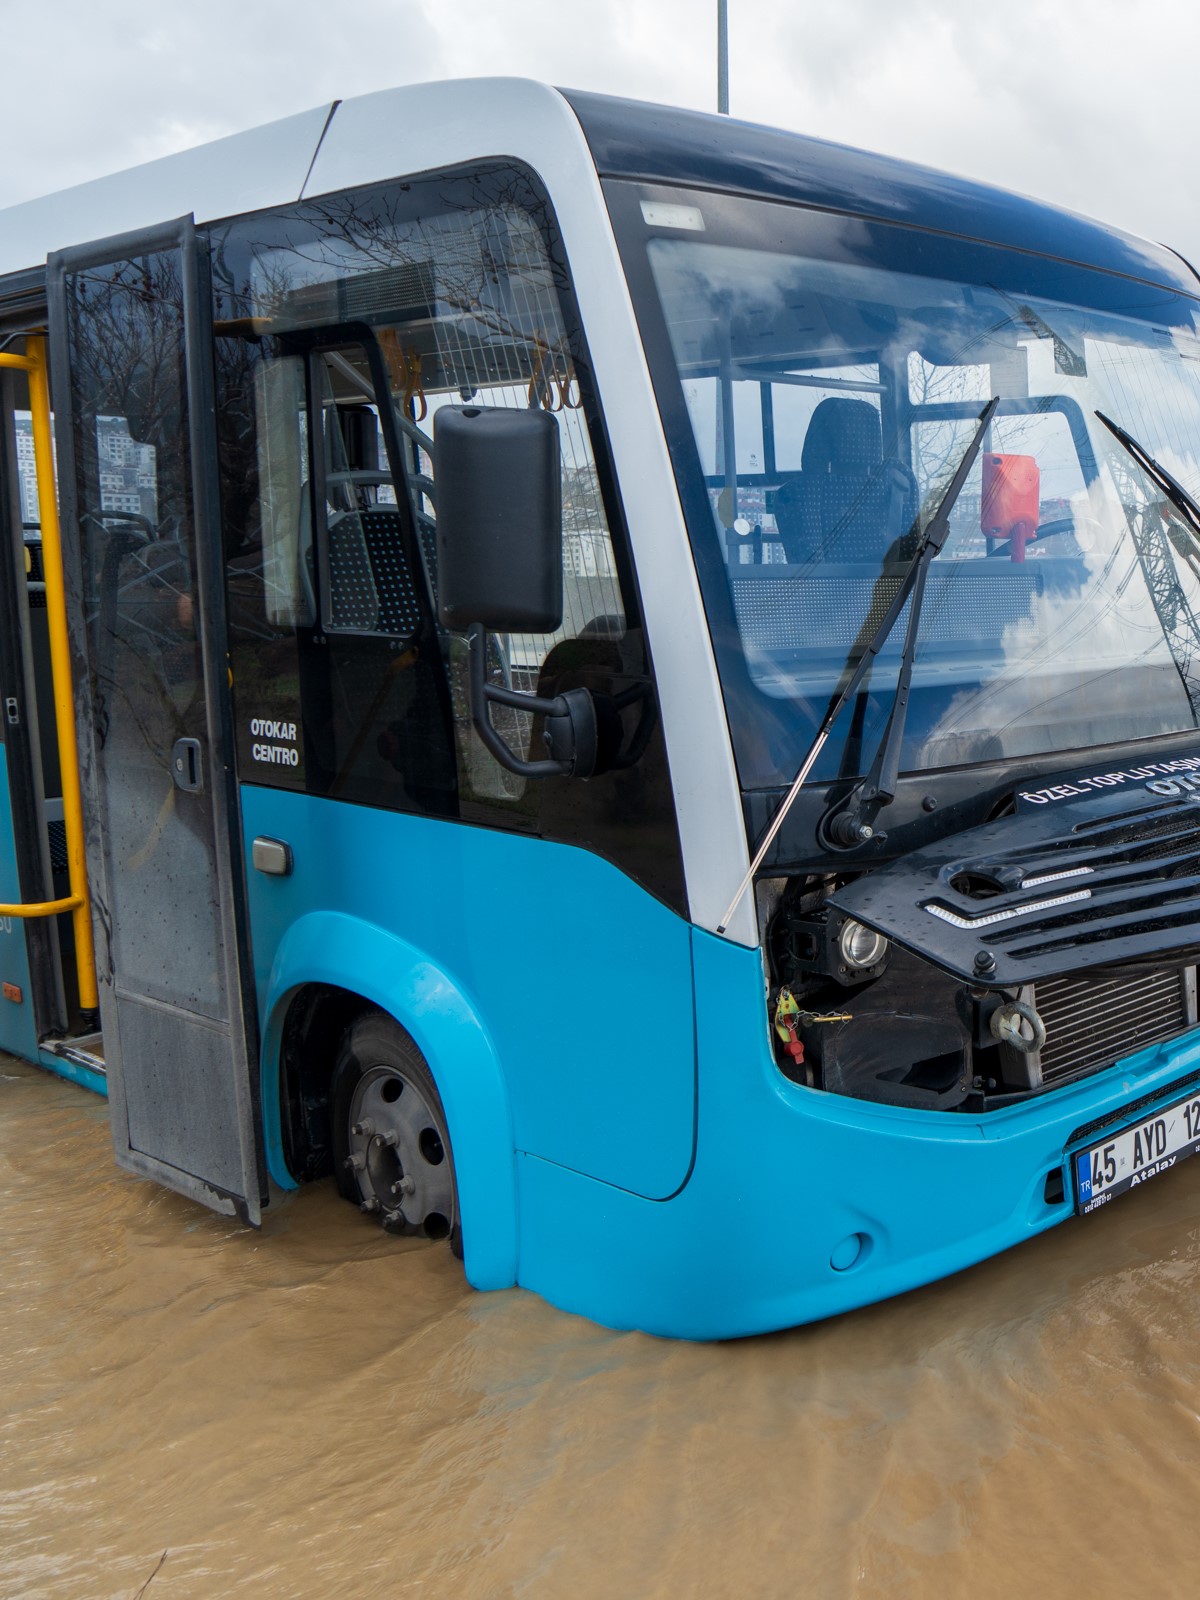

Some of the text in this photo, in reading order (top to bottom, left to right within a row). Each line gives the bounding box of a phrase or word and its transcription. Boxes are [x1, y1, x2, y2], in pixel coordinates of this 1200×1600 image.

[250, 718, 297, 740] OTOKAR
[252, 743, 299, 766] CENTRO
[1019, 784, 1092, 804] ÖZEL
[1092, 1143, 1116, 1189] 45
[1133, 1119, 1167, 1170] AYD
[1130, 1155, 1177, 1188] Atalay
[1081, 1179, 1091, 1193] TR
